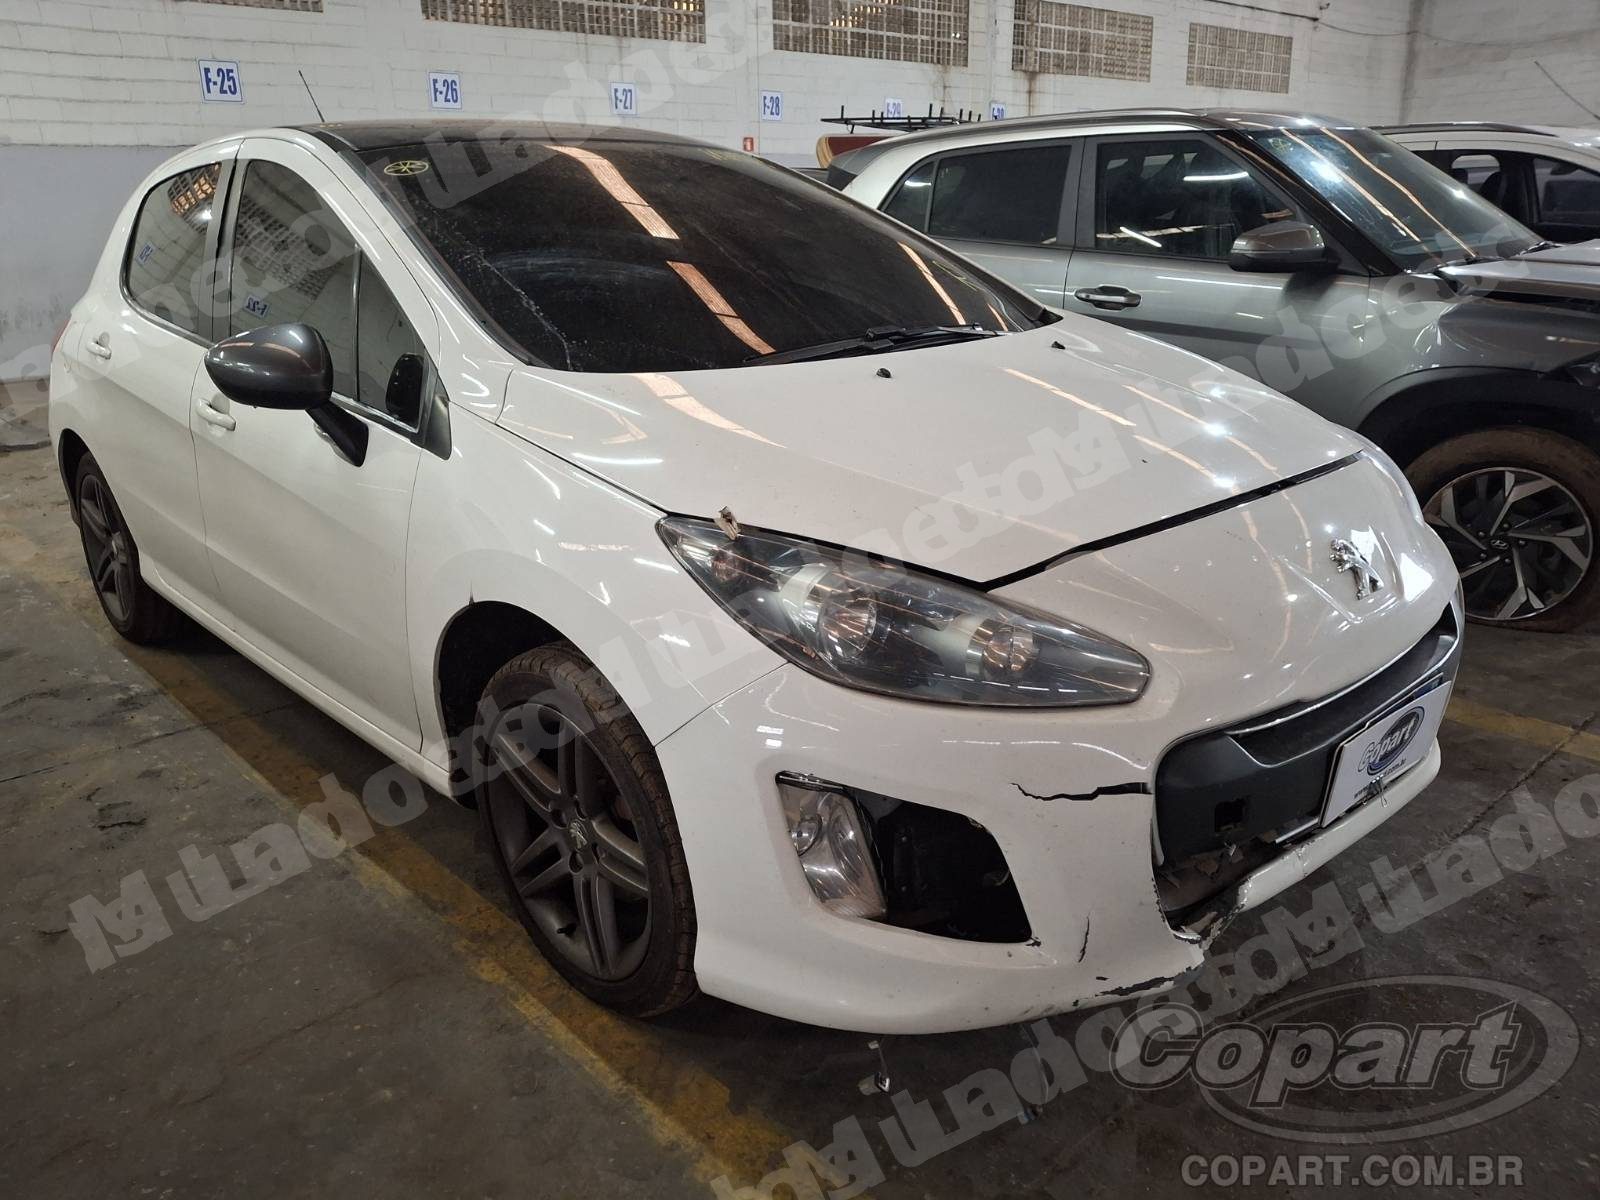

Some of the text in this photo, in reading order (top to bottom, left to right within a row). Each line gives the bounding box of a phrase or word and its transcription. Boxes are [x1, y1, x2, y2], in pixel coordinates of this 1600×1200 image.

[204, 67, 238, 96] F-25
[432, 78, 459, 103] F-26
[614, 88, 633, 110] F-27
[762, 96, 780, 116] F-28
[1358, 716, 1416, 773] Copart
